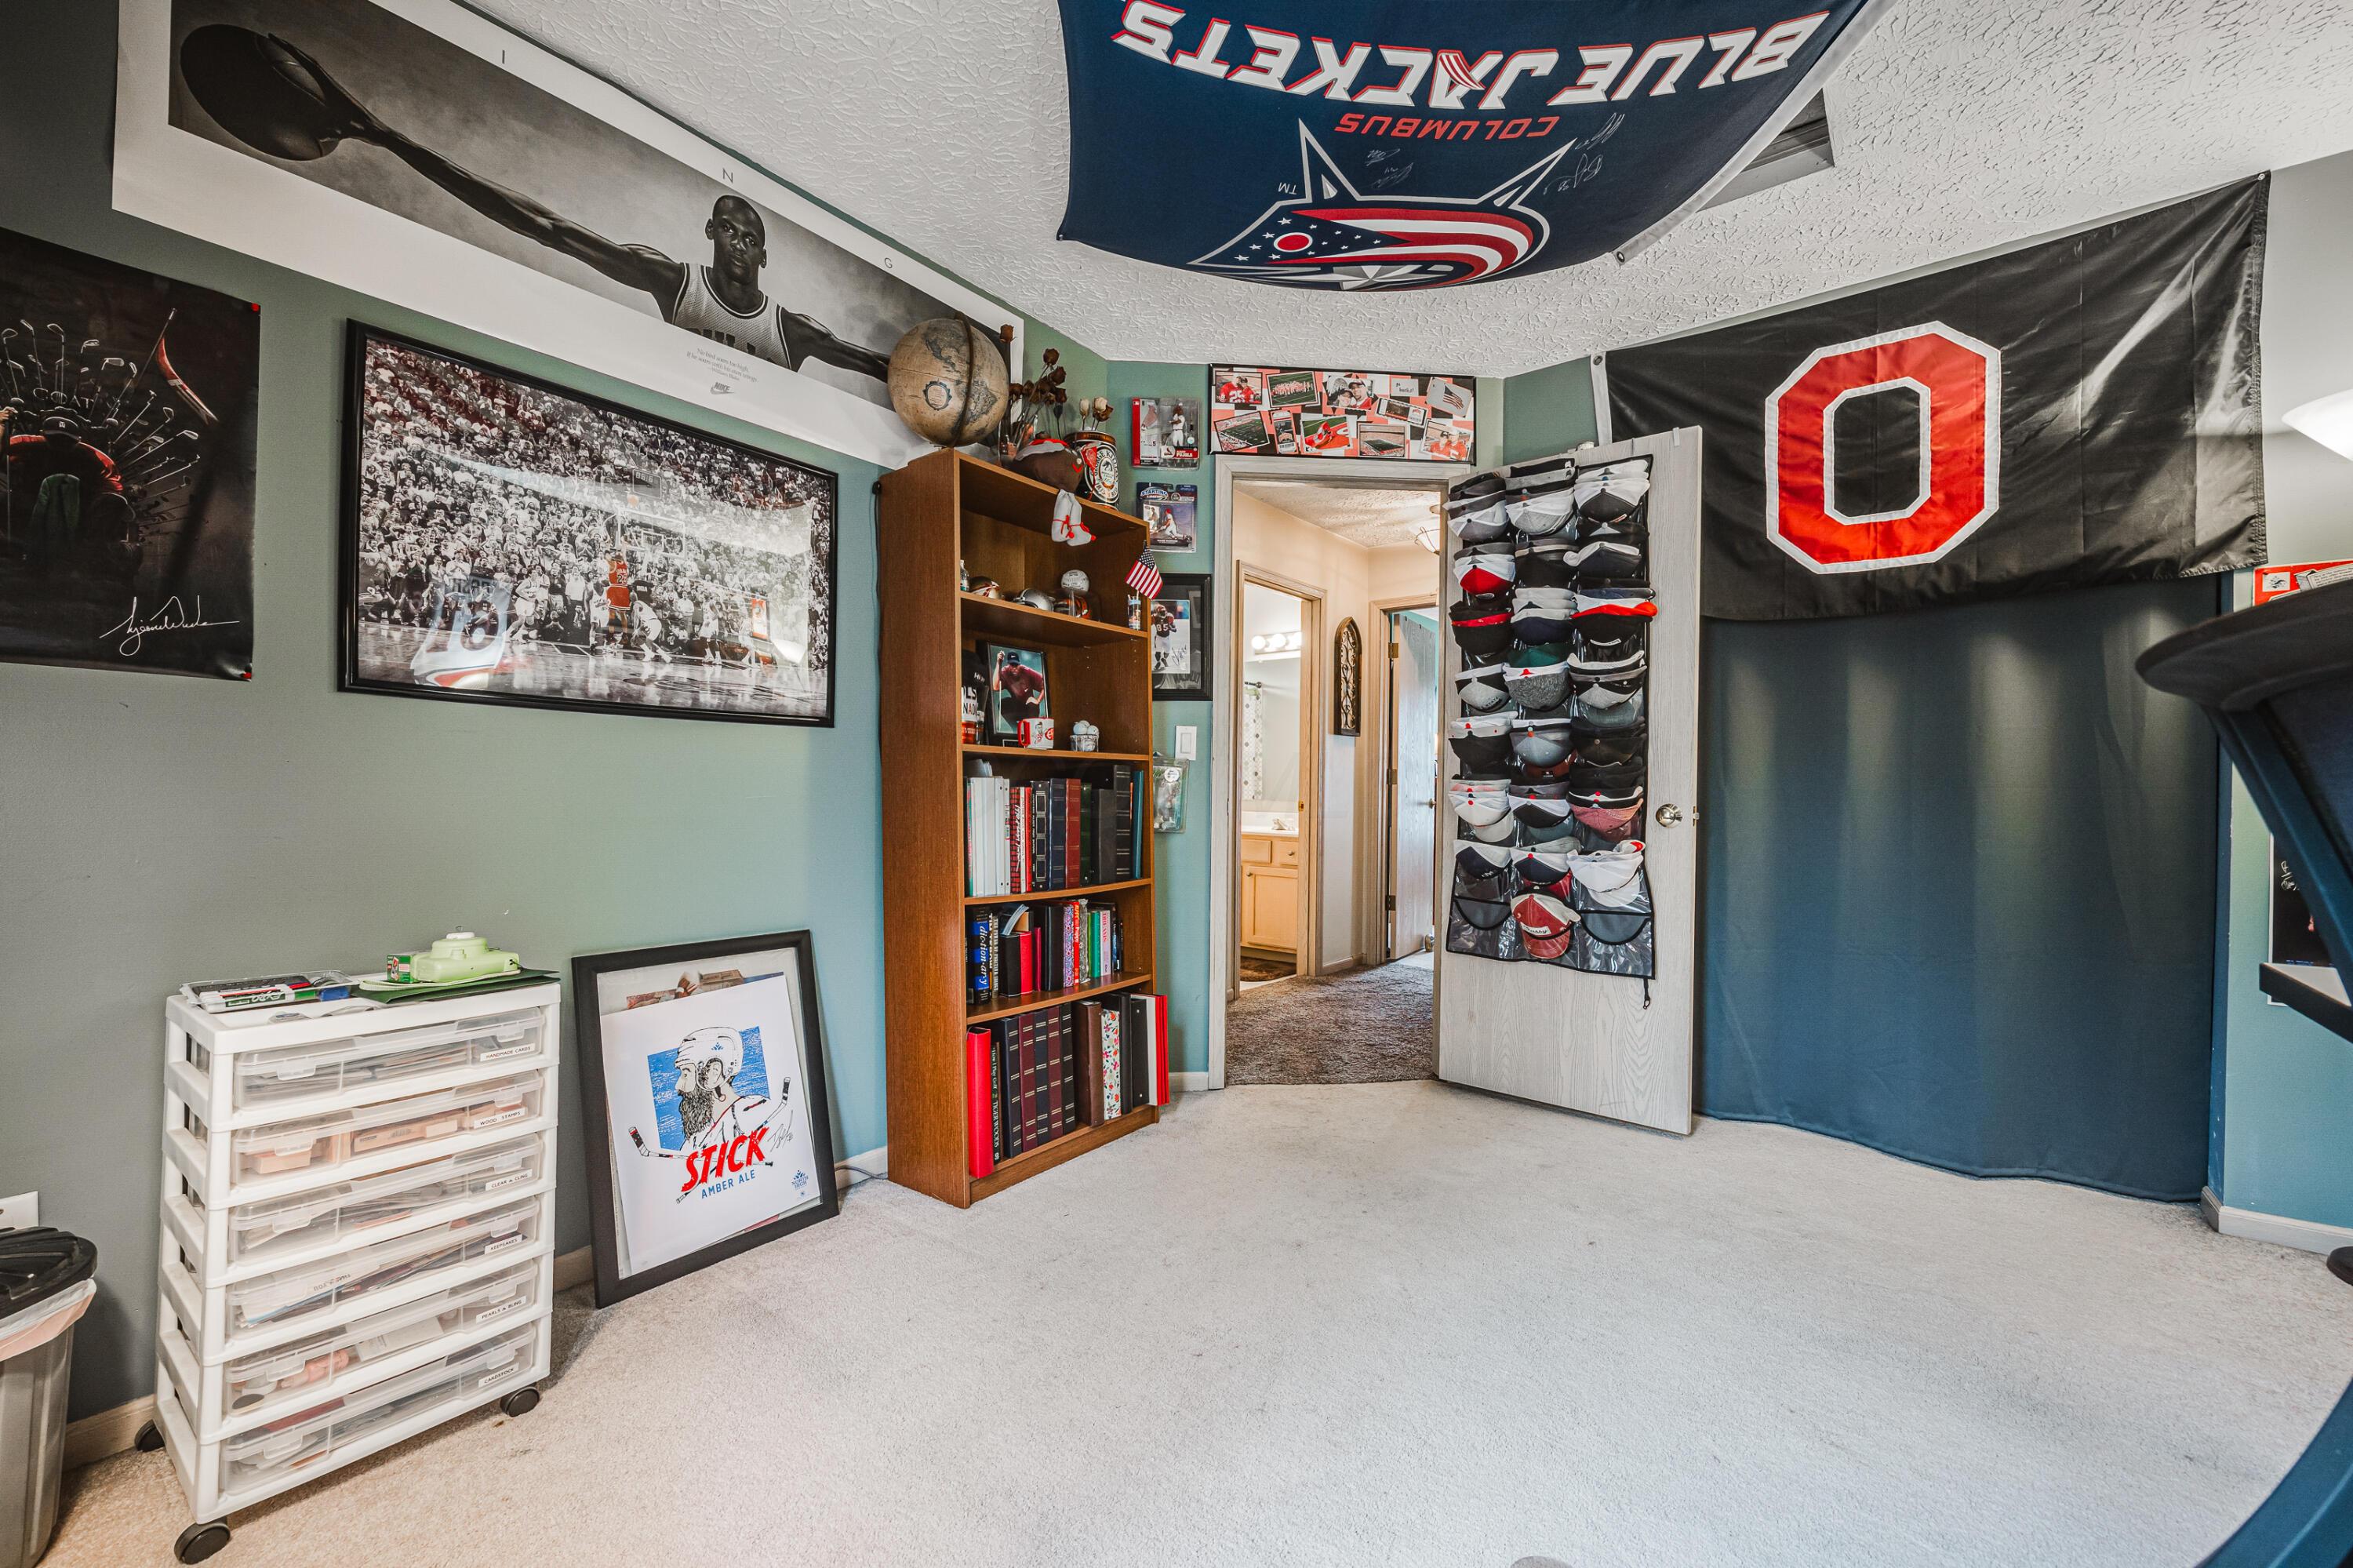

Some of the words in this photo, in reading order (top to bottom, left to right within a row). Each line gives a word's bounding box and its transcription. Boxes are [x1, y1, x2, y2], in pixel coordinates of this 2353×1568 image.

[1111, 0, 1559, 109] JACKETS
[1547, 11, 1830, 108] BLUE
[1333, 111, 1560, 139] COLUMBUS
[1278, 182, 1297, 195] TM
[714, 381, 730, 393] NIKE
[1765, 320, 2001, 575] O
[1156, 623, 1169, 632] 85
[486, 1050, 514, 1059] HANDMADE
[479, 1117, 497, 1126] WOOD
[501, 1111, 521, 1120] STAMPS
[681, 1126, 769, 1192] STICK
[491, 1180, 507, 1188] CLEAR
[701, 1178, 734, 1199] AMBER
[739, 1170, 756, 1184] ALE
[791, 1174, 809, 1186] NORTH
[794, 1180, 808, 1190] HIGH
[490, 1239, 518, 1251] KEEPSAKES
[482, 1308, 500, 1319] PEARLS
[507, 1300, 522, 1308] BLING
[483, 1367, 515, 1384] CARDSTOCK
